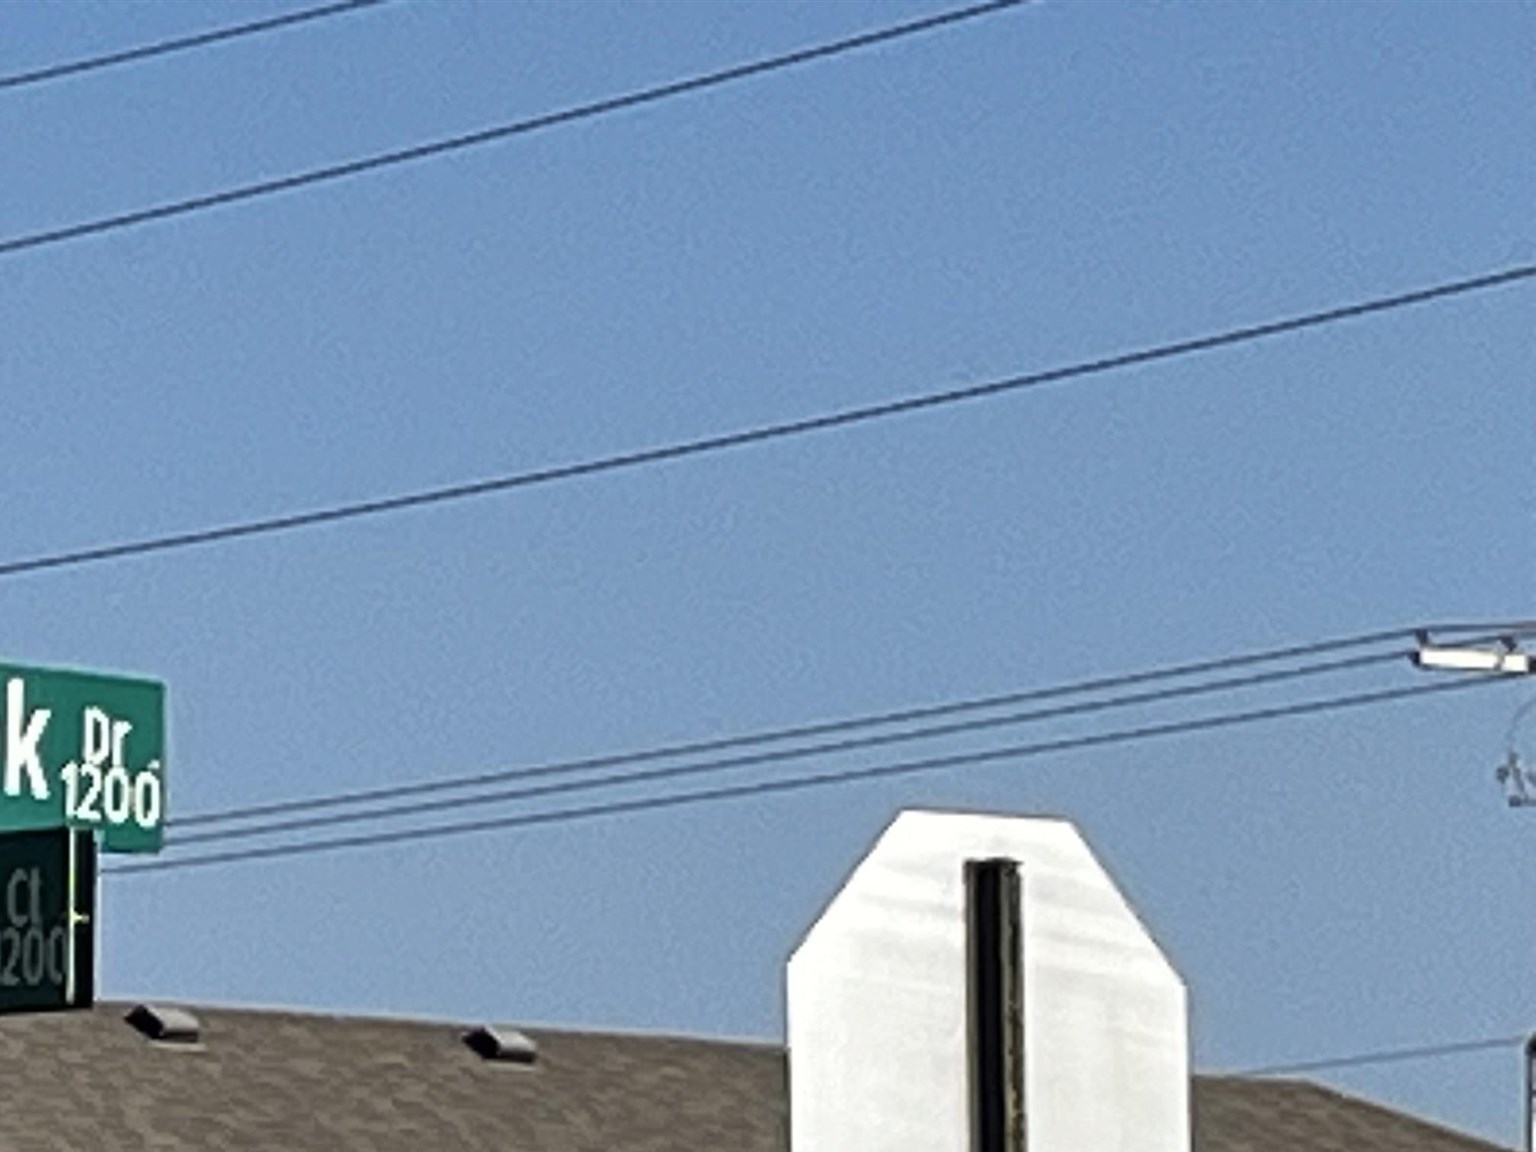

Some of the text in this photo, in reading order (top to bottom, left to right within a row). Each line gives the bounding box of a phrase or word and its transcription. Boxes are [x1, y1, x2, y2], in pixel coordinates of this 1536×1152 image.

[83, 705, 133, 766] Dr
[61, 760, 161, 828] 1200
[7, 867, 41, 928] Ct
